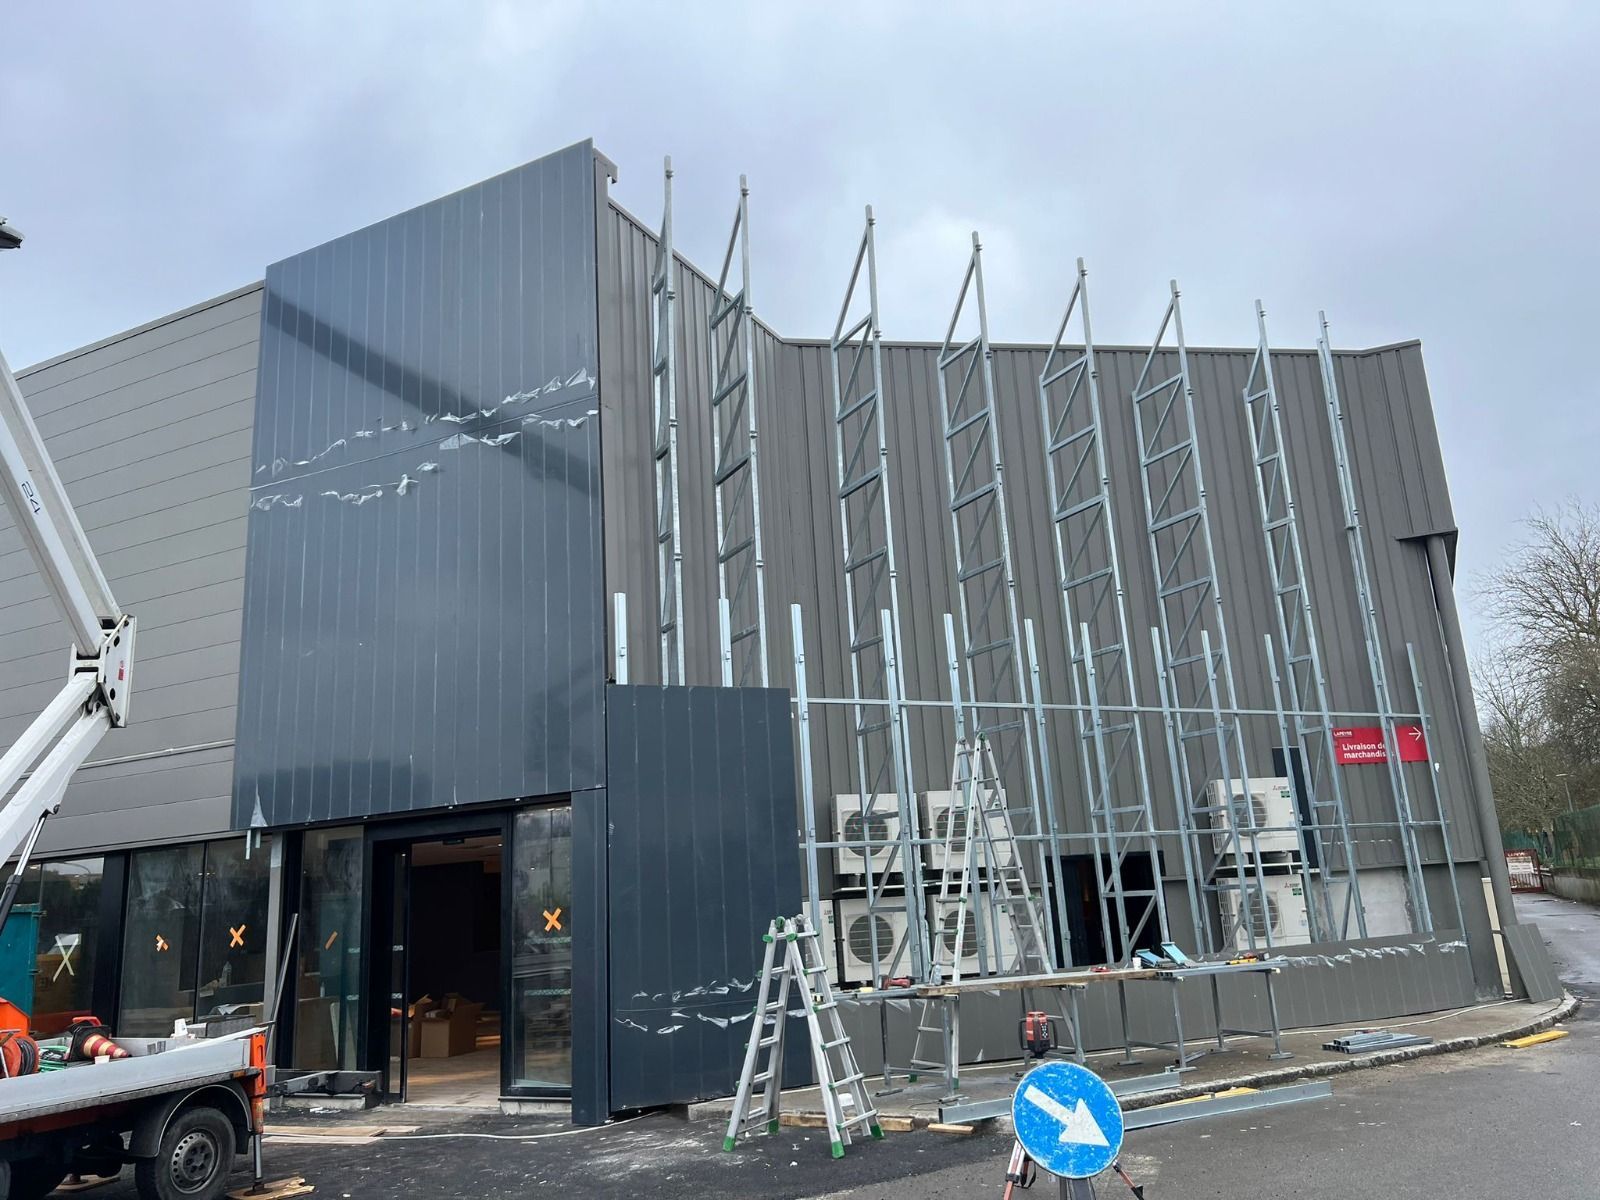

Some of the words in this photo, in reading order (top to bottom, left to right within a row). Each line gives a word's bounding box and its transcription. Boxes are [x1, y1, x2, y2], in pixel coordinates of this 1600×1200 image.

[21, 481, 41, 515] 24
[1342, 742, 1376, 751] Livraison
[1344, 750, 1394, 759] marchandis
